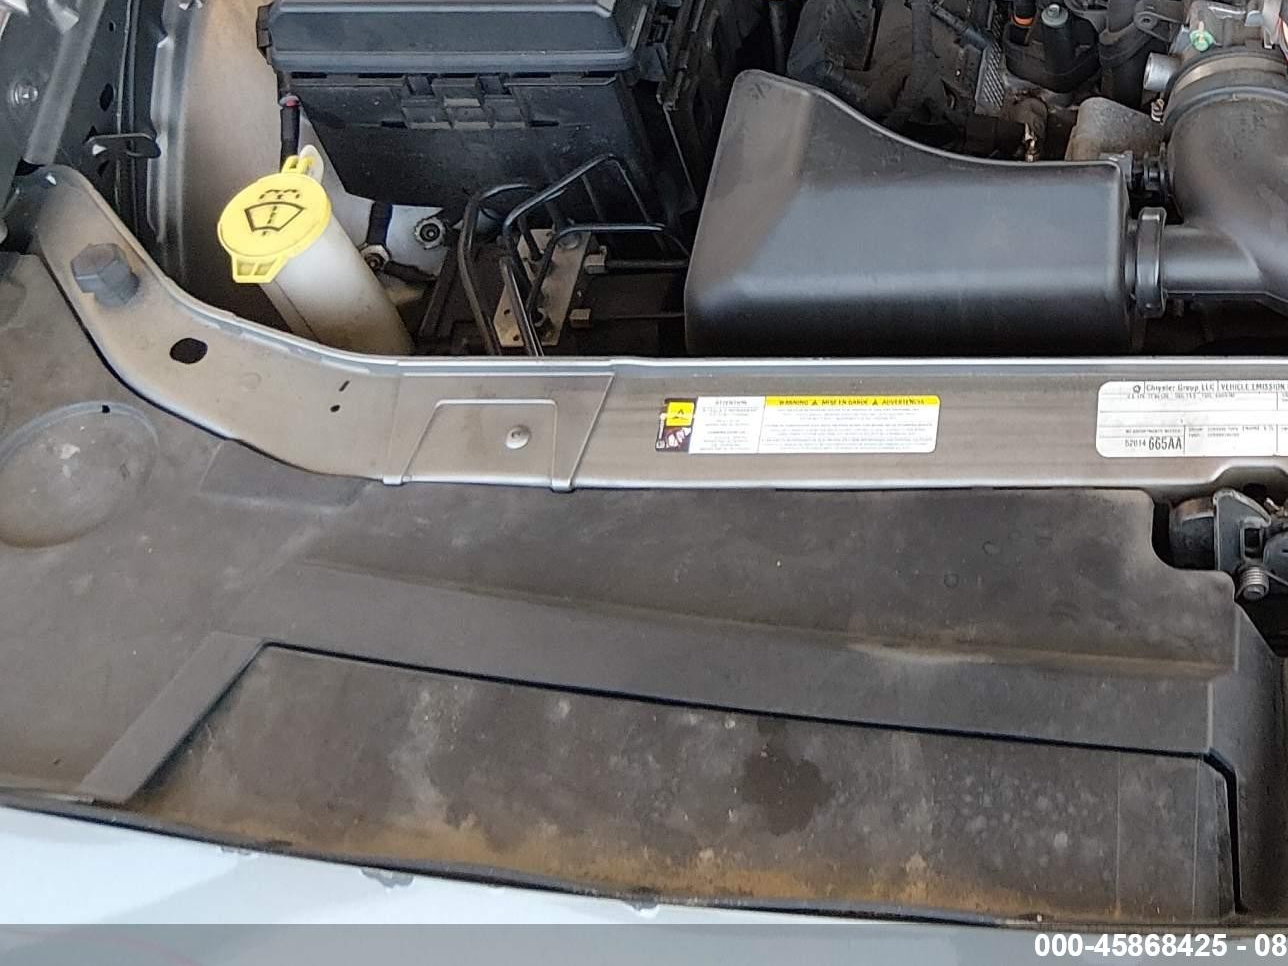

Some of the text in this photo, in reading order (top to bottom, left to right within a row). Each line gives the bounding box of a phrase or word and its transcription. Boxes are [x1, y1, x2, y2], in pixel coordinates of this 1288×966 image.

[1146, 384, 1215, 394] Chrysler Group LLC
[1220, 383, 1250, 391] VEHICLE
[1252, 383, 1285, 391] EMISSION
[1148, 436, 1182, 450] 665AA
